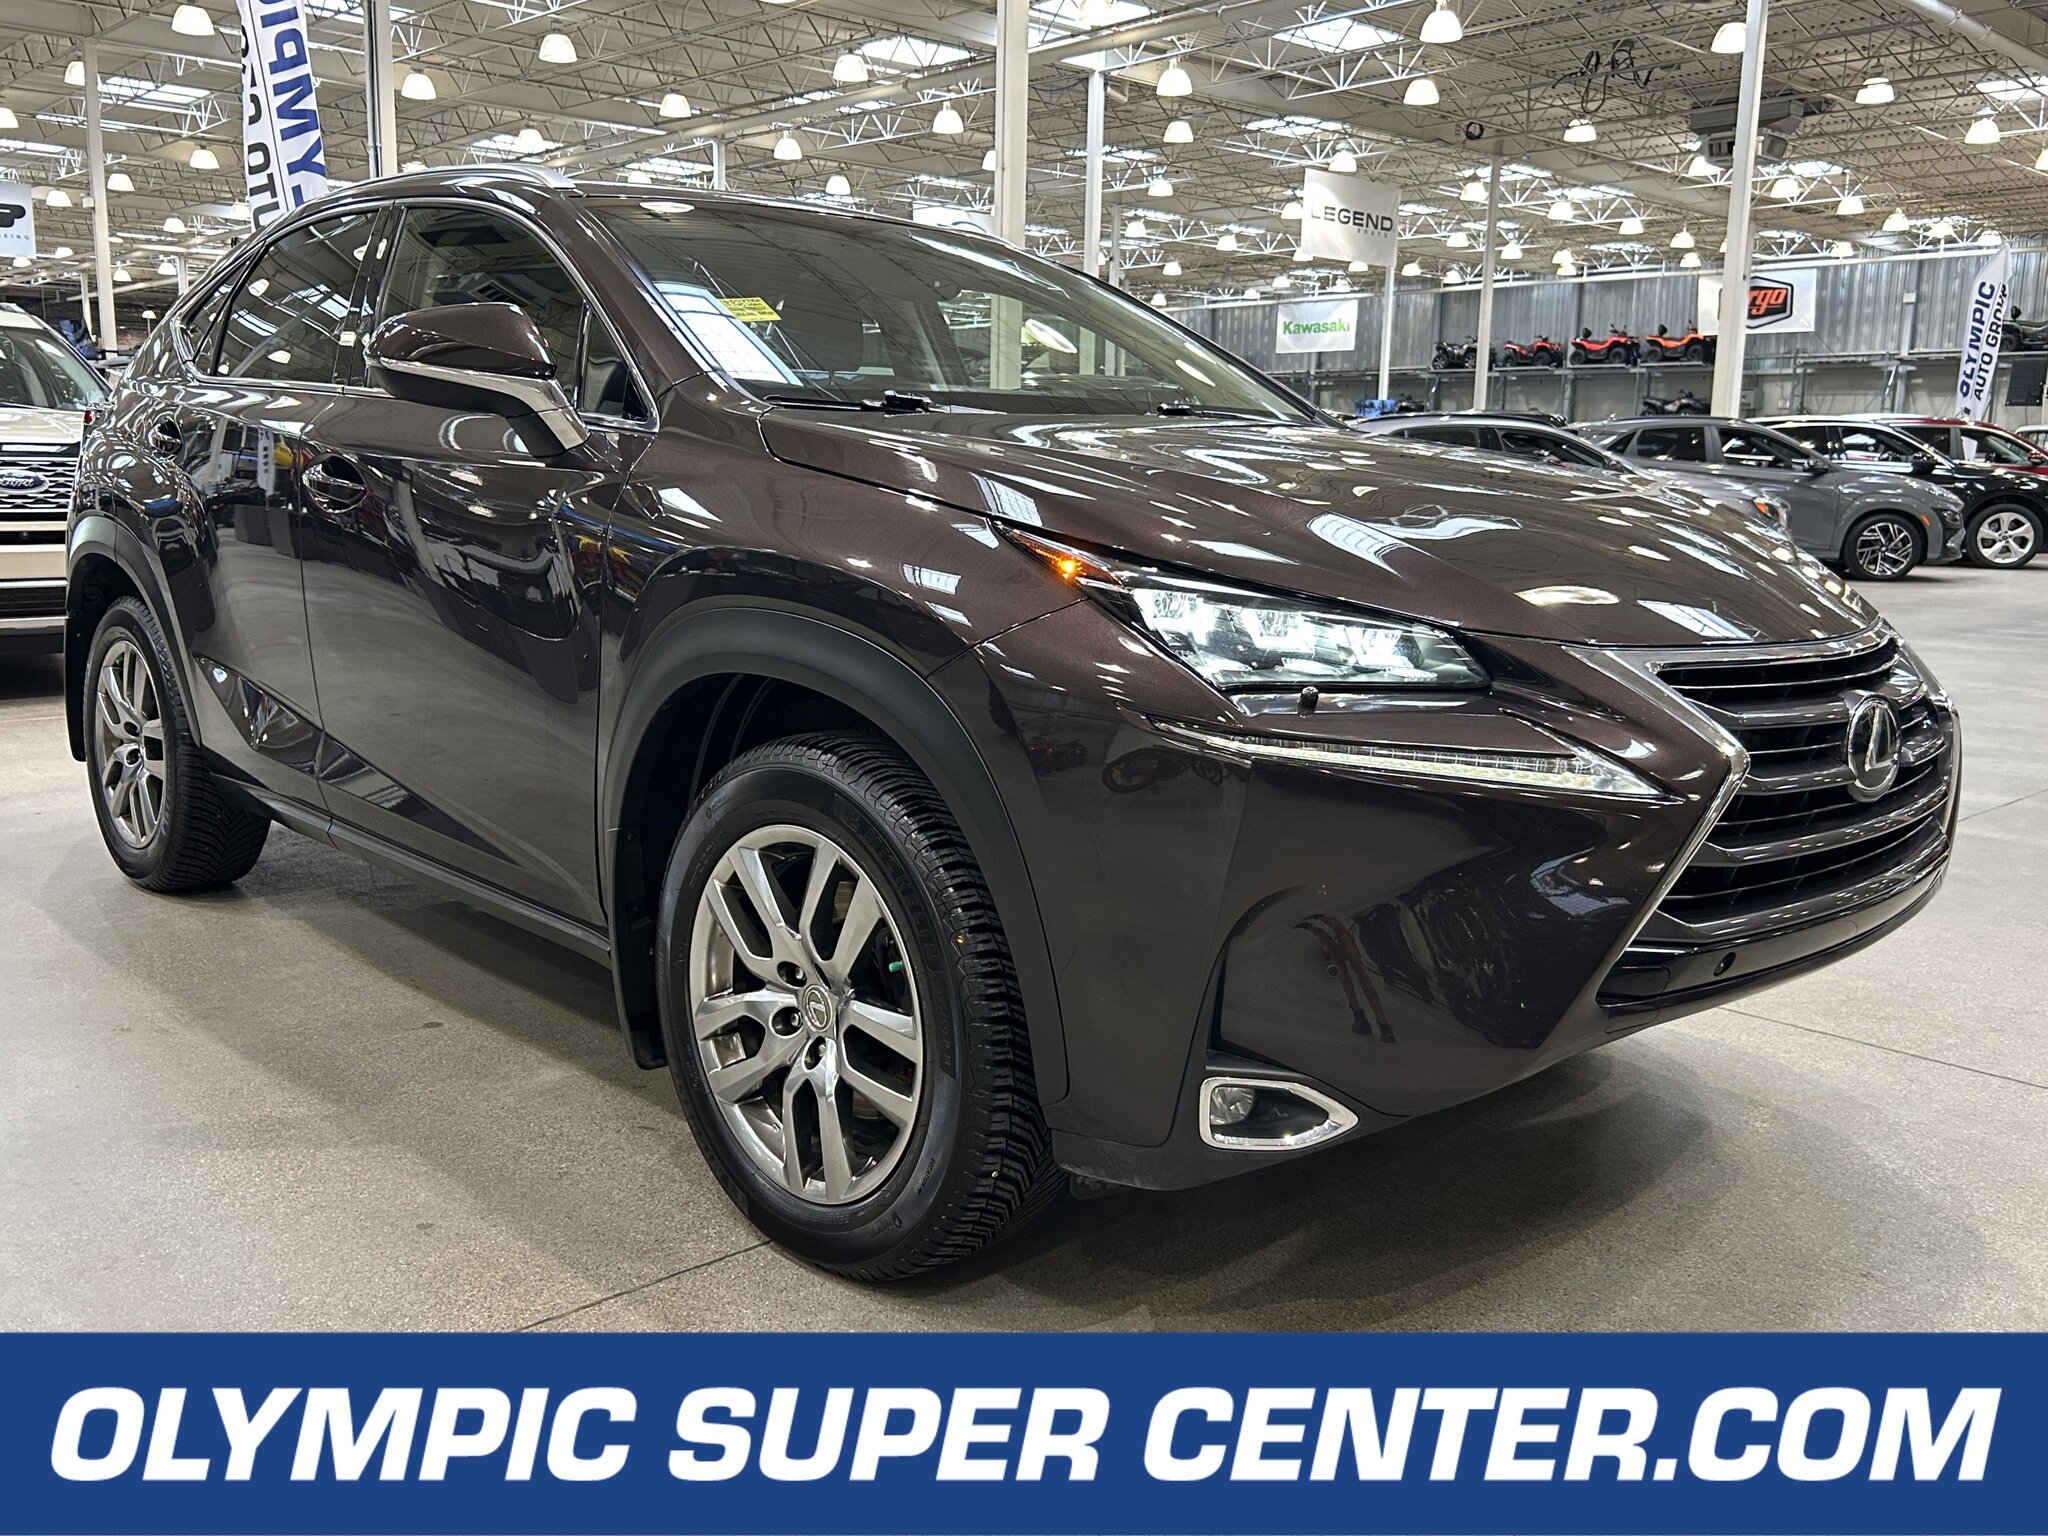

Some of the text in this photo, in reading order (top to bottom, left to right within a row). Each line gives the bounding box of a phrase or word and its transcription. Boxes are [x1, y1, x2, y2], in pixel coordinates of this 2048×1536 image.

[1311, 204, 1394, 232] LEGEND
[1748, 289, 1787, 315] rgo
[1282, 318, 1350, 335] Kawasaki
[1960, 281, 1995, 398] OLYMPIC
[1974, 352, 1993, 401] AUTO
